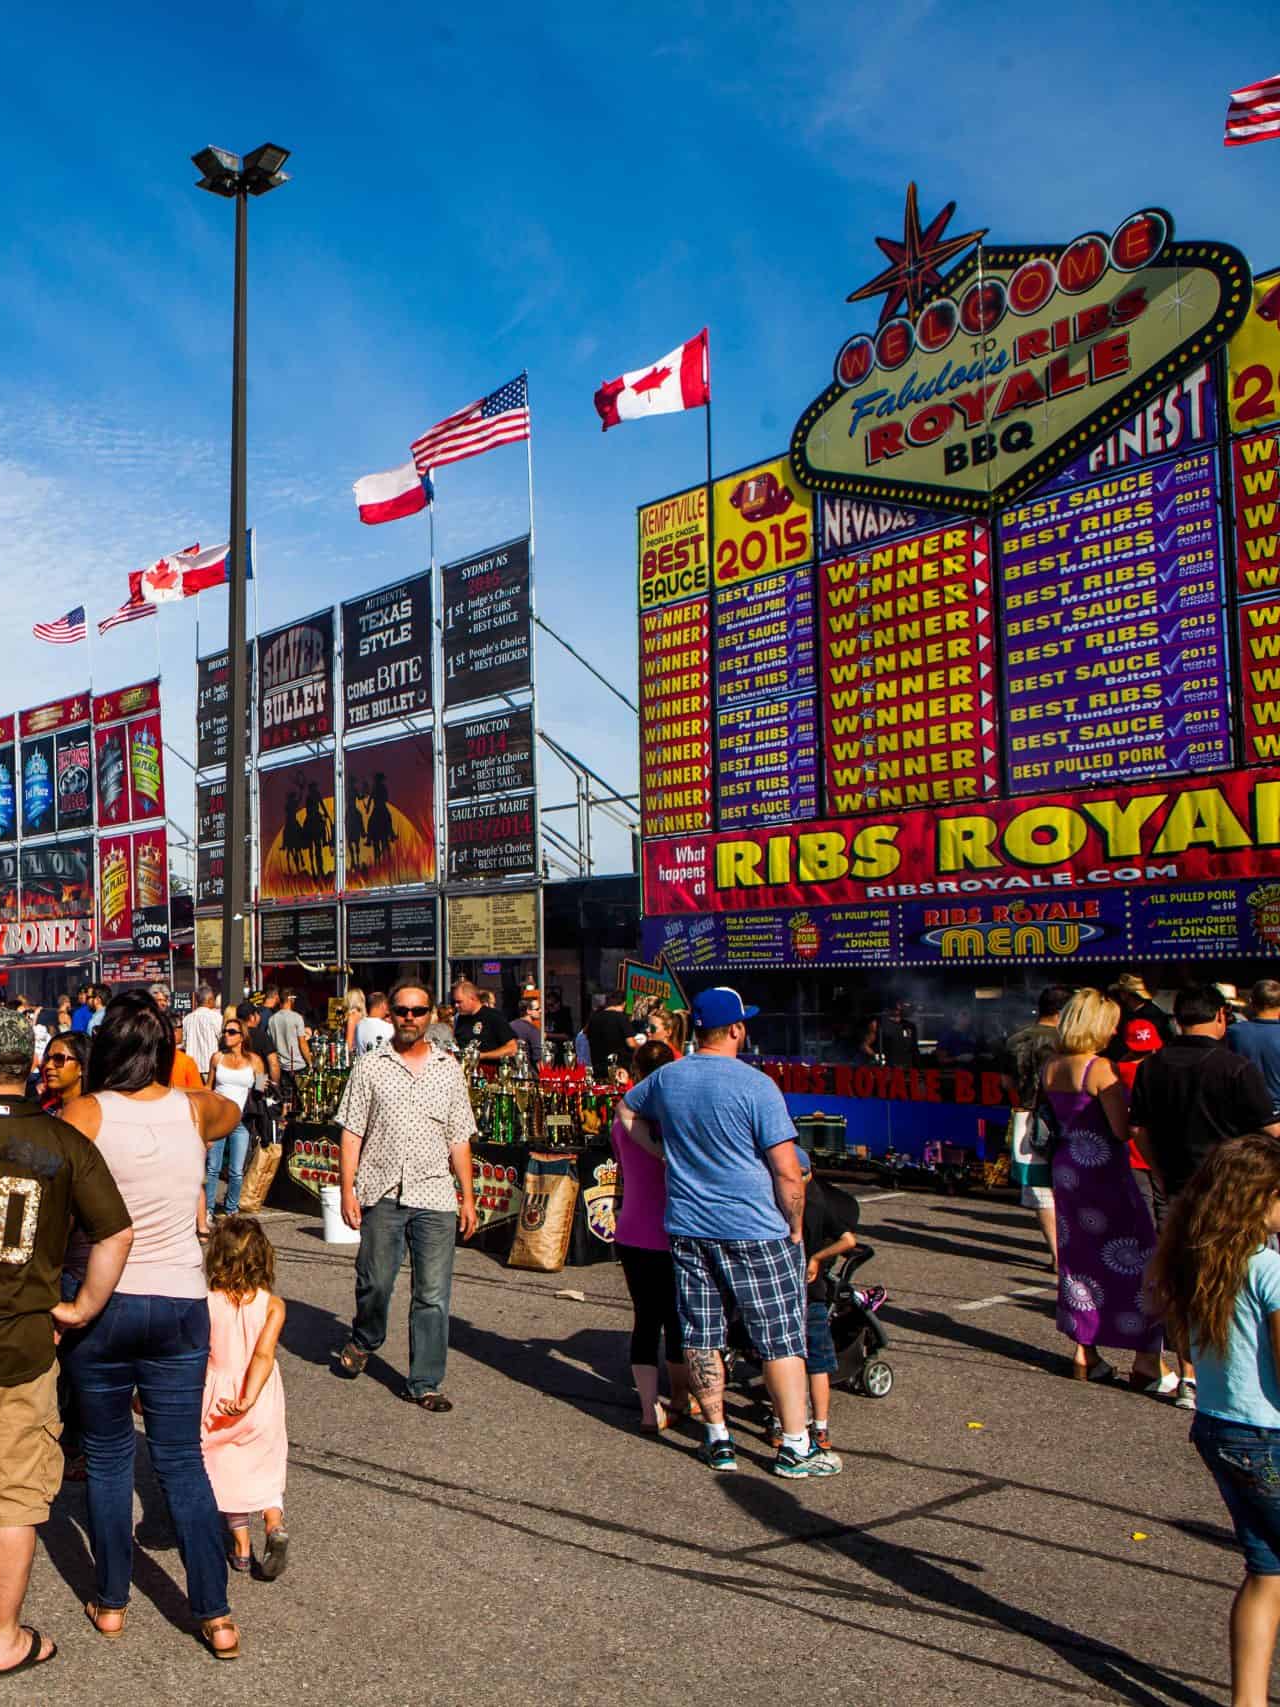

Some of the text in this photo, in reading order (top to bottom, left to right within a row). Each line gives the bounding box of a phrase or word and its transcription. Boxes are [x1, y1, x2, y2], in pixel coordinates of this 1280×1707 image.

[843, 222, 1150, 386] WELCOME
[970, 338, 996, 356] TO
[848, 287, 1150, 438] Fabulous RIBS
[864, 331, 1135, 468] ROYALE
[1089, 361, 1211, 473] FINEST
[943, 420, 1035, 476] BBQ
[1175, 456, 1209, 473] 2015
[1002, 472, 1153, 527] BEST SAUCE
[1176, 488, 1210, 504] 2015
[641, 491, 705, 537] KEMPTVILLE
[1002, 501, 1154, 554] BEST RIBS
[1176, 519, 1212, 536] 2015
[642, 535, 706, 580] BEST
[715, 514, 808, 580] 2015
[1004, 530, 1155, 581] BEST RIBS
[1178, 550, 1214, 566] 2015
[461, 553, 508, 581] SYDNEY NS
[642, 565, 707, 604] SAUCE
[718, 576, 786, 604] BEST RIBS
[1006, 561, 1156, 610] BEST RIBS
[1180, 581, 1216, 597] 2015
[359, 598, 412, 632] TEXAS
[446, 585, 520, 630] 1st Judge's Choice
[473, 600, 511, 620] BEST RIBS
[1007, 590, 1158, 637] BEST SAUCE
[1180, 614, 1216, 629] 2015
[473, 611, 519, 635] BEST SAUCE
[359, 623, 412, 657] STYLE
[1008, 621, 1159, 665] BEST RIBS
[1181, 645, 1217, 660] 2015
[448, 635, 526, 679] 1st People's Choice
[474, 648, 528, 671] BEST CHICKEN
[720, 646, 787, 672] BEST RIBS
[347, 656, 422, 701] COME BITE
[1010, 652, 1161, 694] BEST SAUCE
[1183, 677, 1218, 691] 2015
[264, 680, 326, 729] BULLET
[349, 691, 415, 723] THE BULLET
[720, 702, 788, 726] BEST RIBS
[1010, 683, 1162, 723] BEST RIBS
[1184, 709, 1220, 722] 2015
[465, 718, 510, 738] MONCTON
[1012, 714, 1164, 752] BEST SAUCE
[1188, 740, 1224, 754] 2015
[448, 751, 529, 789] 1st People's Choice
[476, 768, 496, 780] BEST
[1013, 744, 1166, 780] BEST PULLED PORK
[477, 779, 497, 791] BEST
[720, 776, 789, 796] BEST RIBS
[452, 798, 528, 821] SAULT MARIE
[720, 800, 790, 820] BEST SAUCE
[473, 846, 503, 857] People's
[505, 843, 532, 853] Choice
[478, 854, 533, 869] BEST CHICKEN
[676, 846, 706, 864] What
[716, 825, 901, 890] RIBS
[659, 865, 706, 886] happens
[694, 880, 706, 896] at
[866, 864, 1178, 898] RIBSROYALE.COM
[1170, 890, 1236, 903] PULLED PORK
[924, 900, 1100, 926] RIBS ROYALE
[5, 918, 92, 953] BONES
[1180, 925, 1238, 937] DINNER
